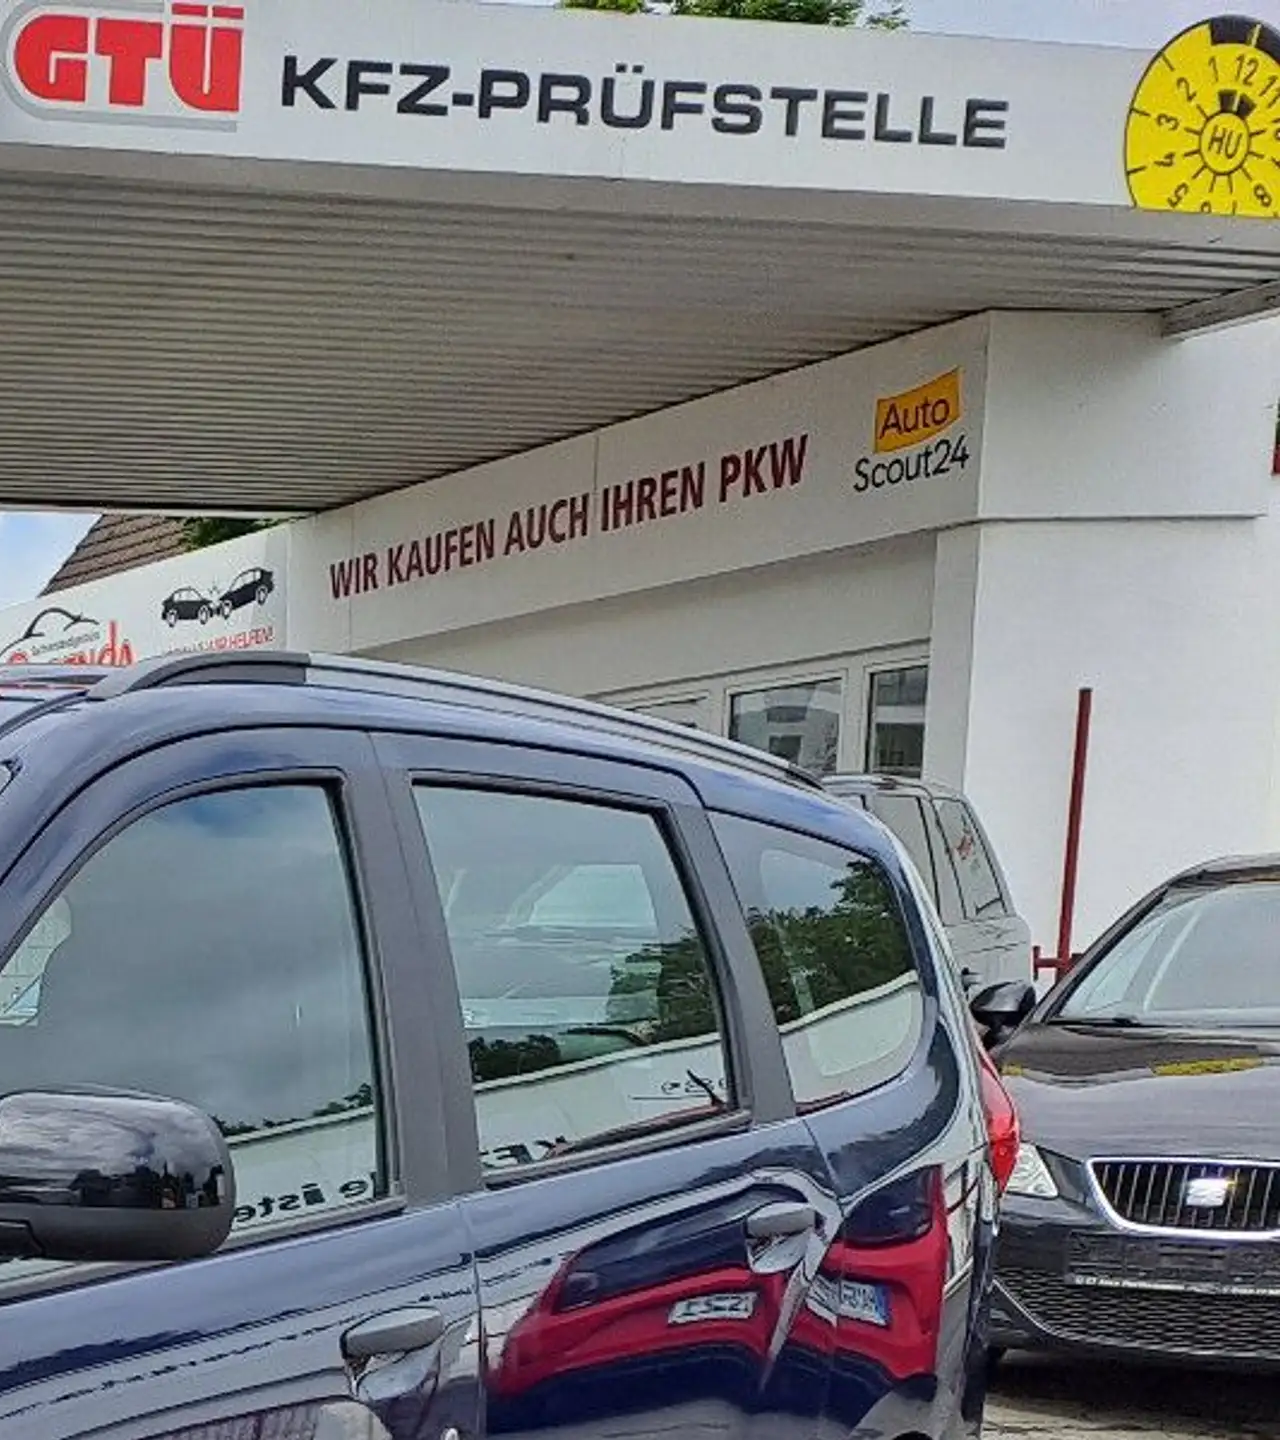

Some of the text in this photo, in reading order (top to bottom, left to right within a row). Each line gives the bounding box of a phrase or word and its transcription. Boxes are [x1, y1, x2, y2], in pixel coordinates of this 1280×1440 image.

[15, 3, 244, 112] GTÜ
[282, 55, 1009, 149] KFZ-PRÜFSTELLE
[1208, 125, 1242, 159] HU
[880, 397, 949, 440] Auto
[853, 434, 970, 492] Scout24
[329, 434, 809, 599] WIR KAUFEN AUCH IHREN PKW
